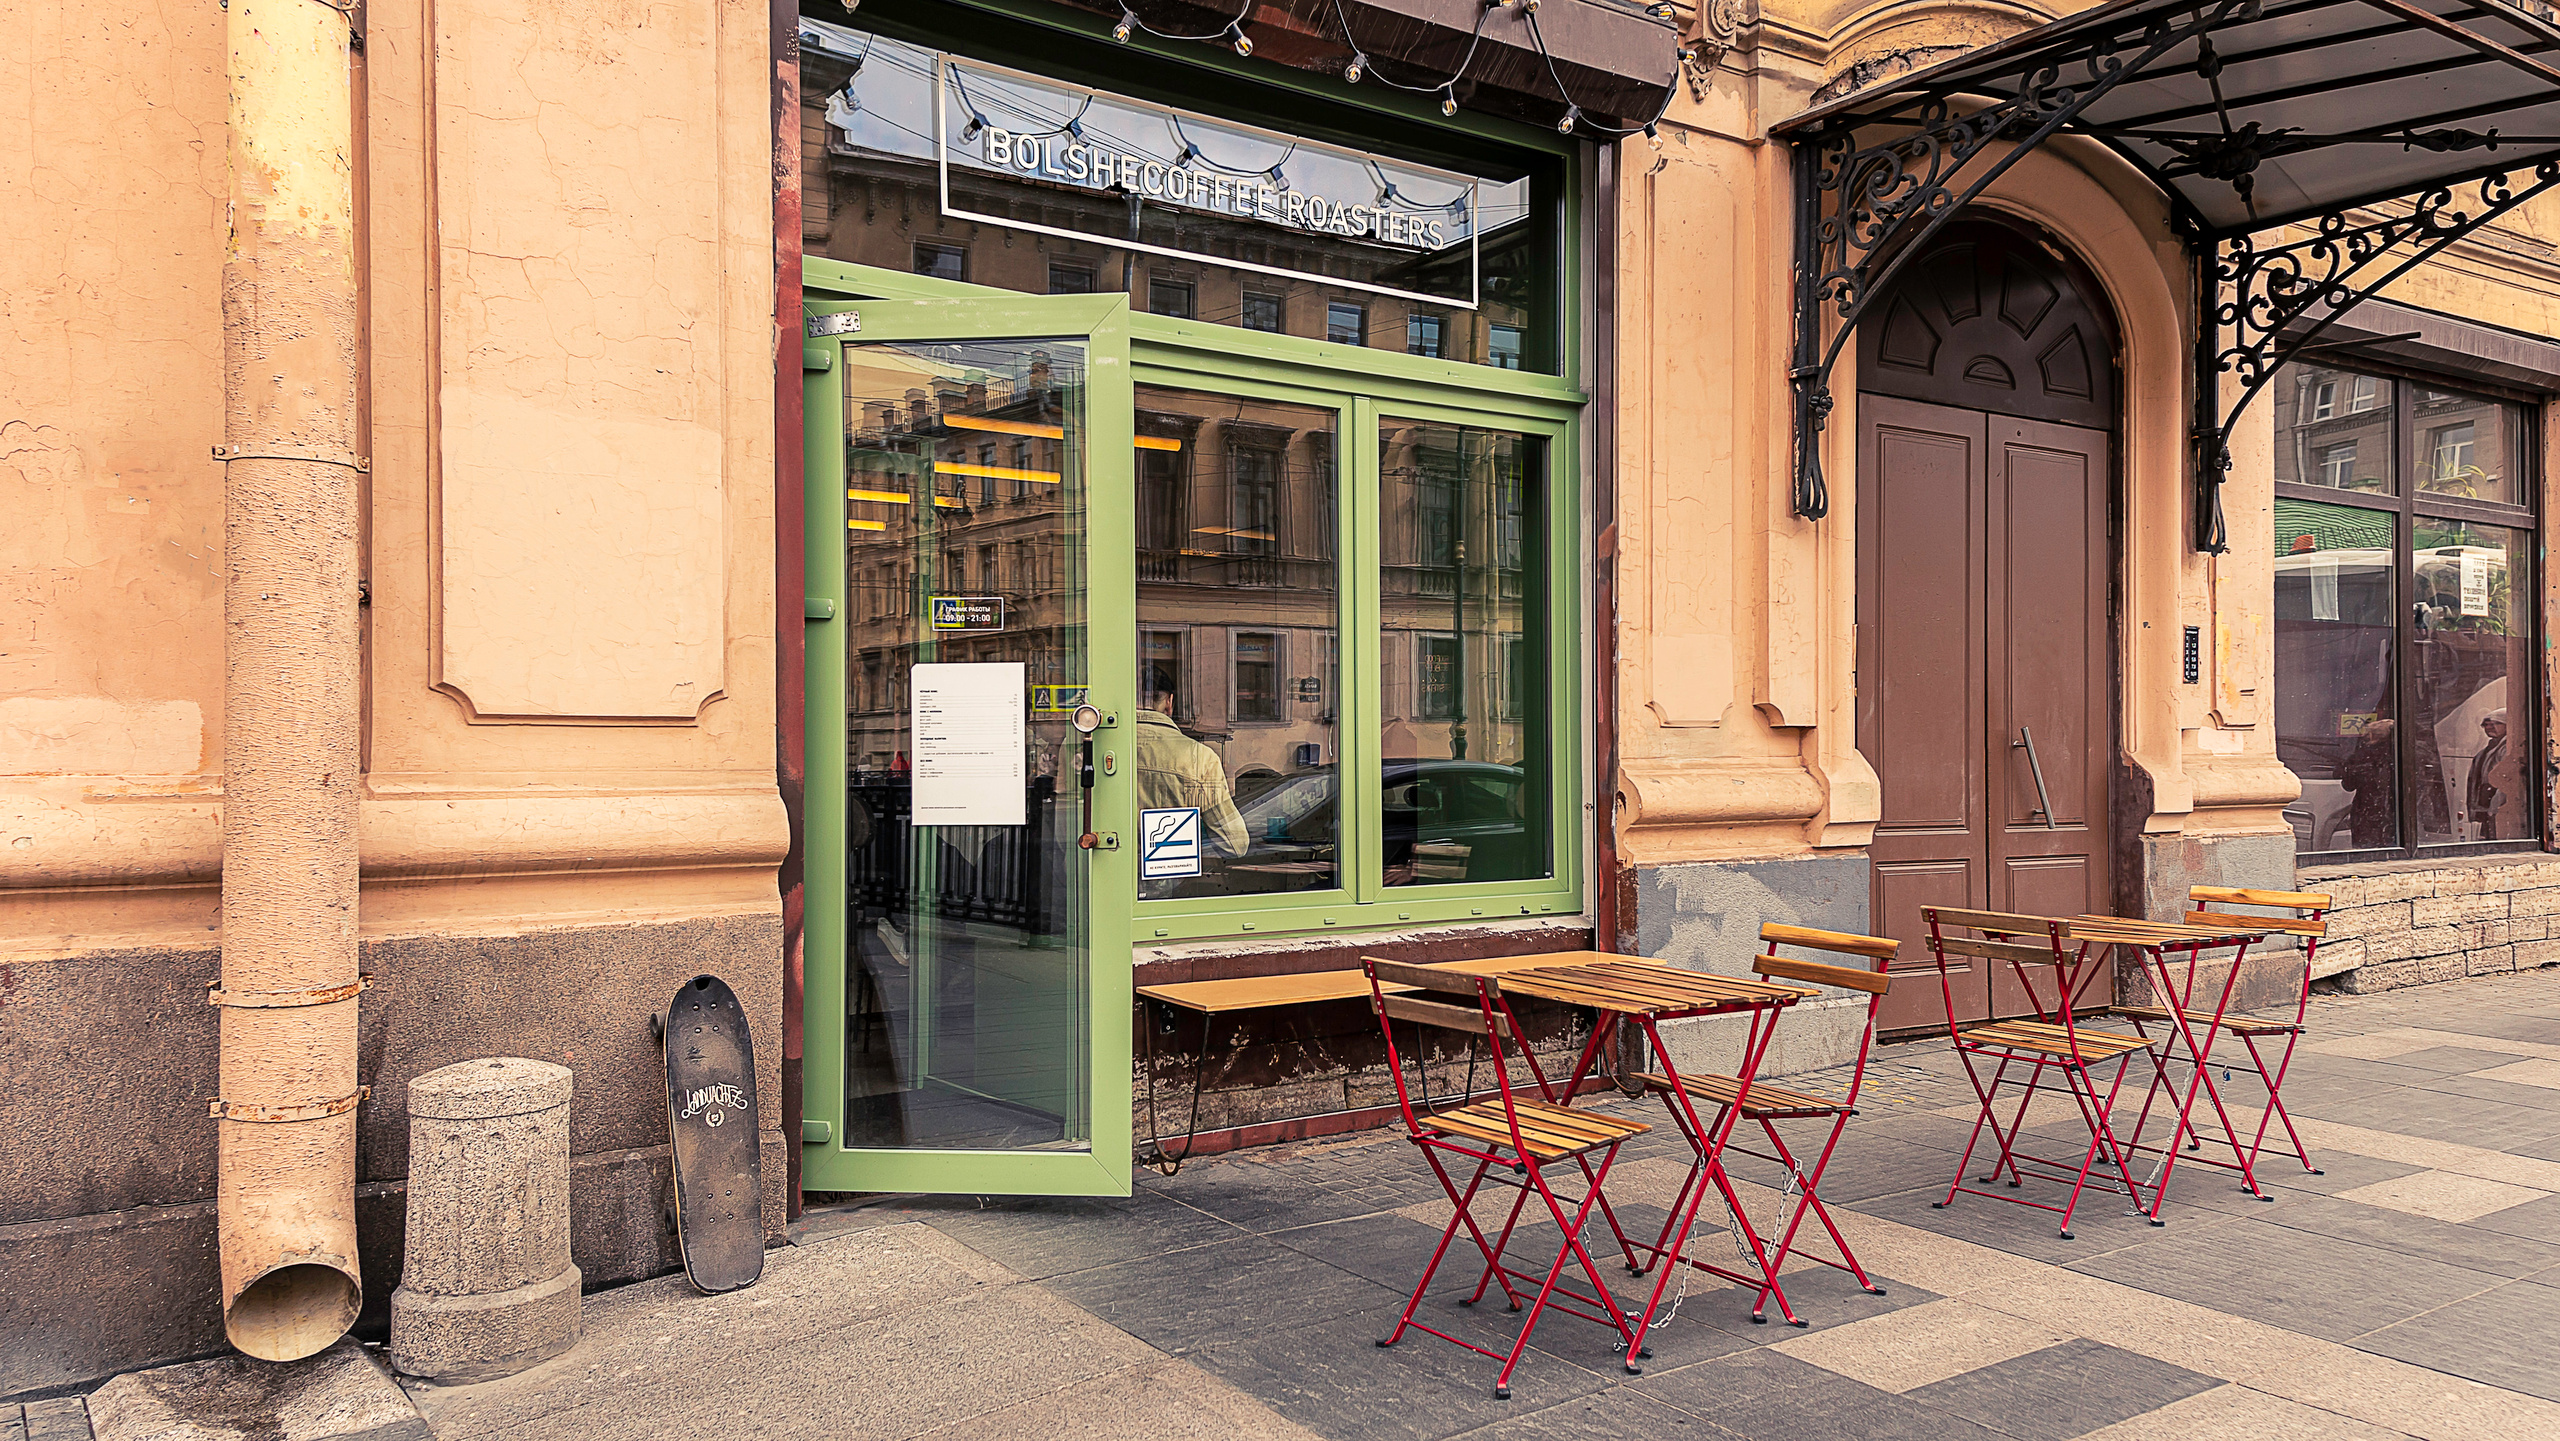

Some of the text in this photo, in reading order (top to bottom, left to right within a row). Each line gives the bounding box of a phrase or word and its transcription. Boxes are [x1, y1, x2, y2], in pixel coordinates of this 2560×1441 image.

[987, 126, 1446, 252] BOLSHECOFFEE ROASTERS
[945, 614, 965, 622] 09:00
[970, 614, 991, 622] 21:00
